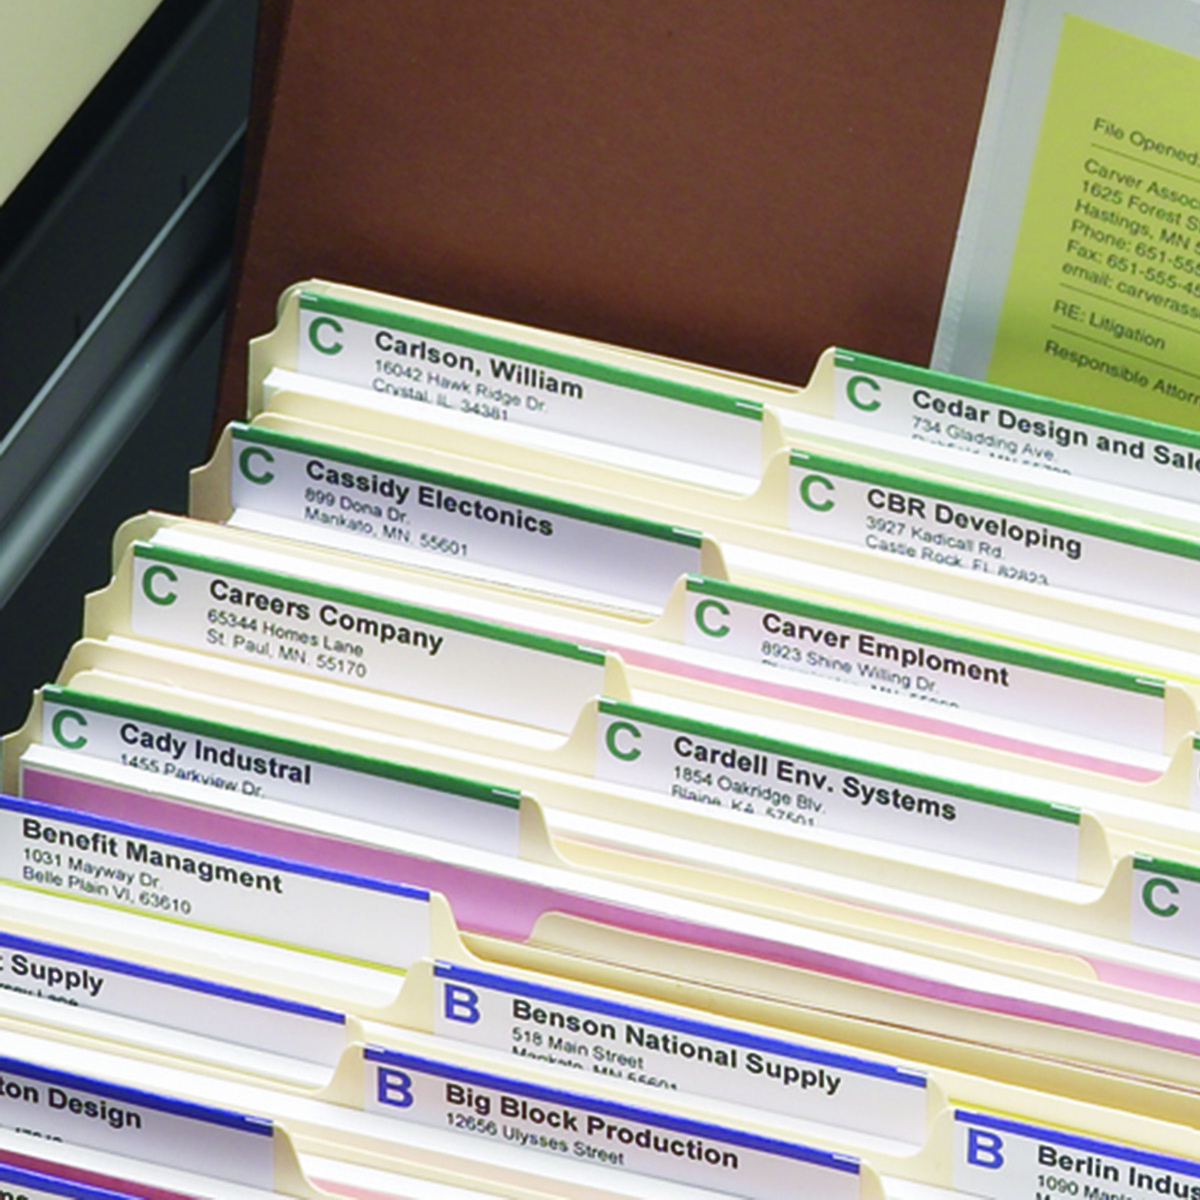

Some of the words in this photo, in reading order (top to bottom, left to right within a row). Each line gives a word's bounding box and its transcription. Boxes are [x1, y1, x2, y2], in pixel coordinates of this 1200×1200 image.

[1093, 118, 1125, 140] File
[1084, 159, 1142, 190] Carver
[1076, 199, 1153, 241] Hastings,
[1159, 229, 1190, 250] MN
[1082, 180, 1123, 205] 1625
[1127, 196, 1182, 225] Forest
[1068, 240, 1101, 264] Fax:
[1071, 220, 1131, 252] Phone:
[1062, 262, 1112, 289] email:
[1053, 299, 1084, 323] RE:
[1089, 312, 1165, 351] Litigation
[375, 331, 481, 375] Carlson,
[489, 358, 584, 399] William
[1044, 339, 1148, 387] Responsible
[912, 389, 991, 423] Cedar
[998, 409, 1089, 447] Design
[1096, 433, 1148, 463] and
[306, 461, 410, 504] Cassidy
[418, 486, 554, 536] Electonics
[867, 489, 926, 519] CBR
[935, 504, 1083, 559] Developing
[207, 609, 258, 632] 65344
[262, 622, 319, 646] Homes
[323, 636, 364, 657] Lane
[210, 580, 309, 620] Careers
[320, 605, 444, 656] Company
[207, 629, 229, 647] St.
[234, 635, 273, 658] Paul,
[316, 657, 366, 677] 55170
[762, 613, 850, 649] Carver
[858, 635, 1009, 688] Emploment
[120, 723, 187, 760] Cady
[195, 740, 311, 786] Industral
[673, 736, 768, 775] Cardell
[777, 760, 834, 792] Env.
[843, 777, 956, 822] Systems
[22, 818, 117, 854] Benefit
[125, 836, 283, 894] Managment
[22, 847, 63, 867] 1031
[68, 857, 136, 885] Mayway
[139, 873, 164, 890] Dr.
[22, 866, 63, 887] Belle
[68, 875, 109, 896] Plain
[139, 892, 191, 915] 63610
[11, 955, 103, 995] Supply
[512, 999, 616, 1040] Benson
[625, 1025, 738, 1068] National
[746, 1054, 842, 1095] Supply
[512, 1027, 544, 1045] 518
[548, 1037, 589, 1056] Main
[593, 1049, 644, 1069] Street
[49, 1087, 142, 1129] Design
[446, 1083, 491, 1116] Big
[500, 1096, 578, 1132] Block
[587, 1116, 739, 1169] Production
[448, 1113, 498, 1136] 12656
[503, 1123, 568, 1152] Ulysses
[573, 1142, 625, 1166] Street
[1038, 1145, 1119, 1181] Berlin
